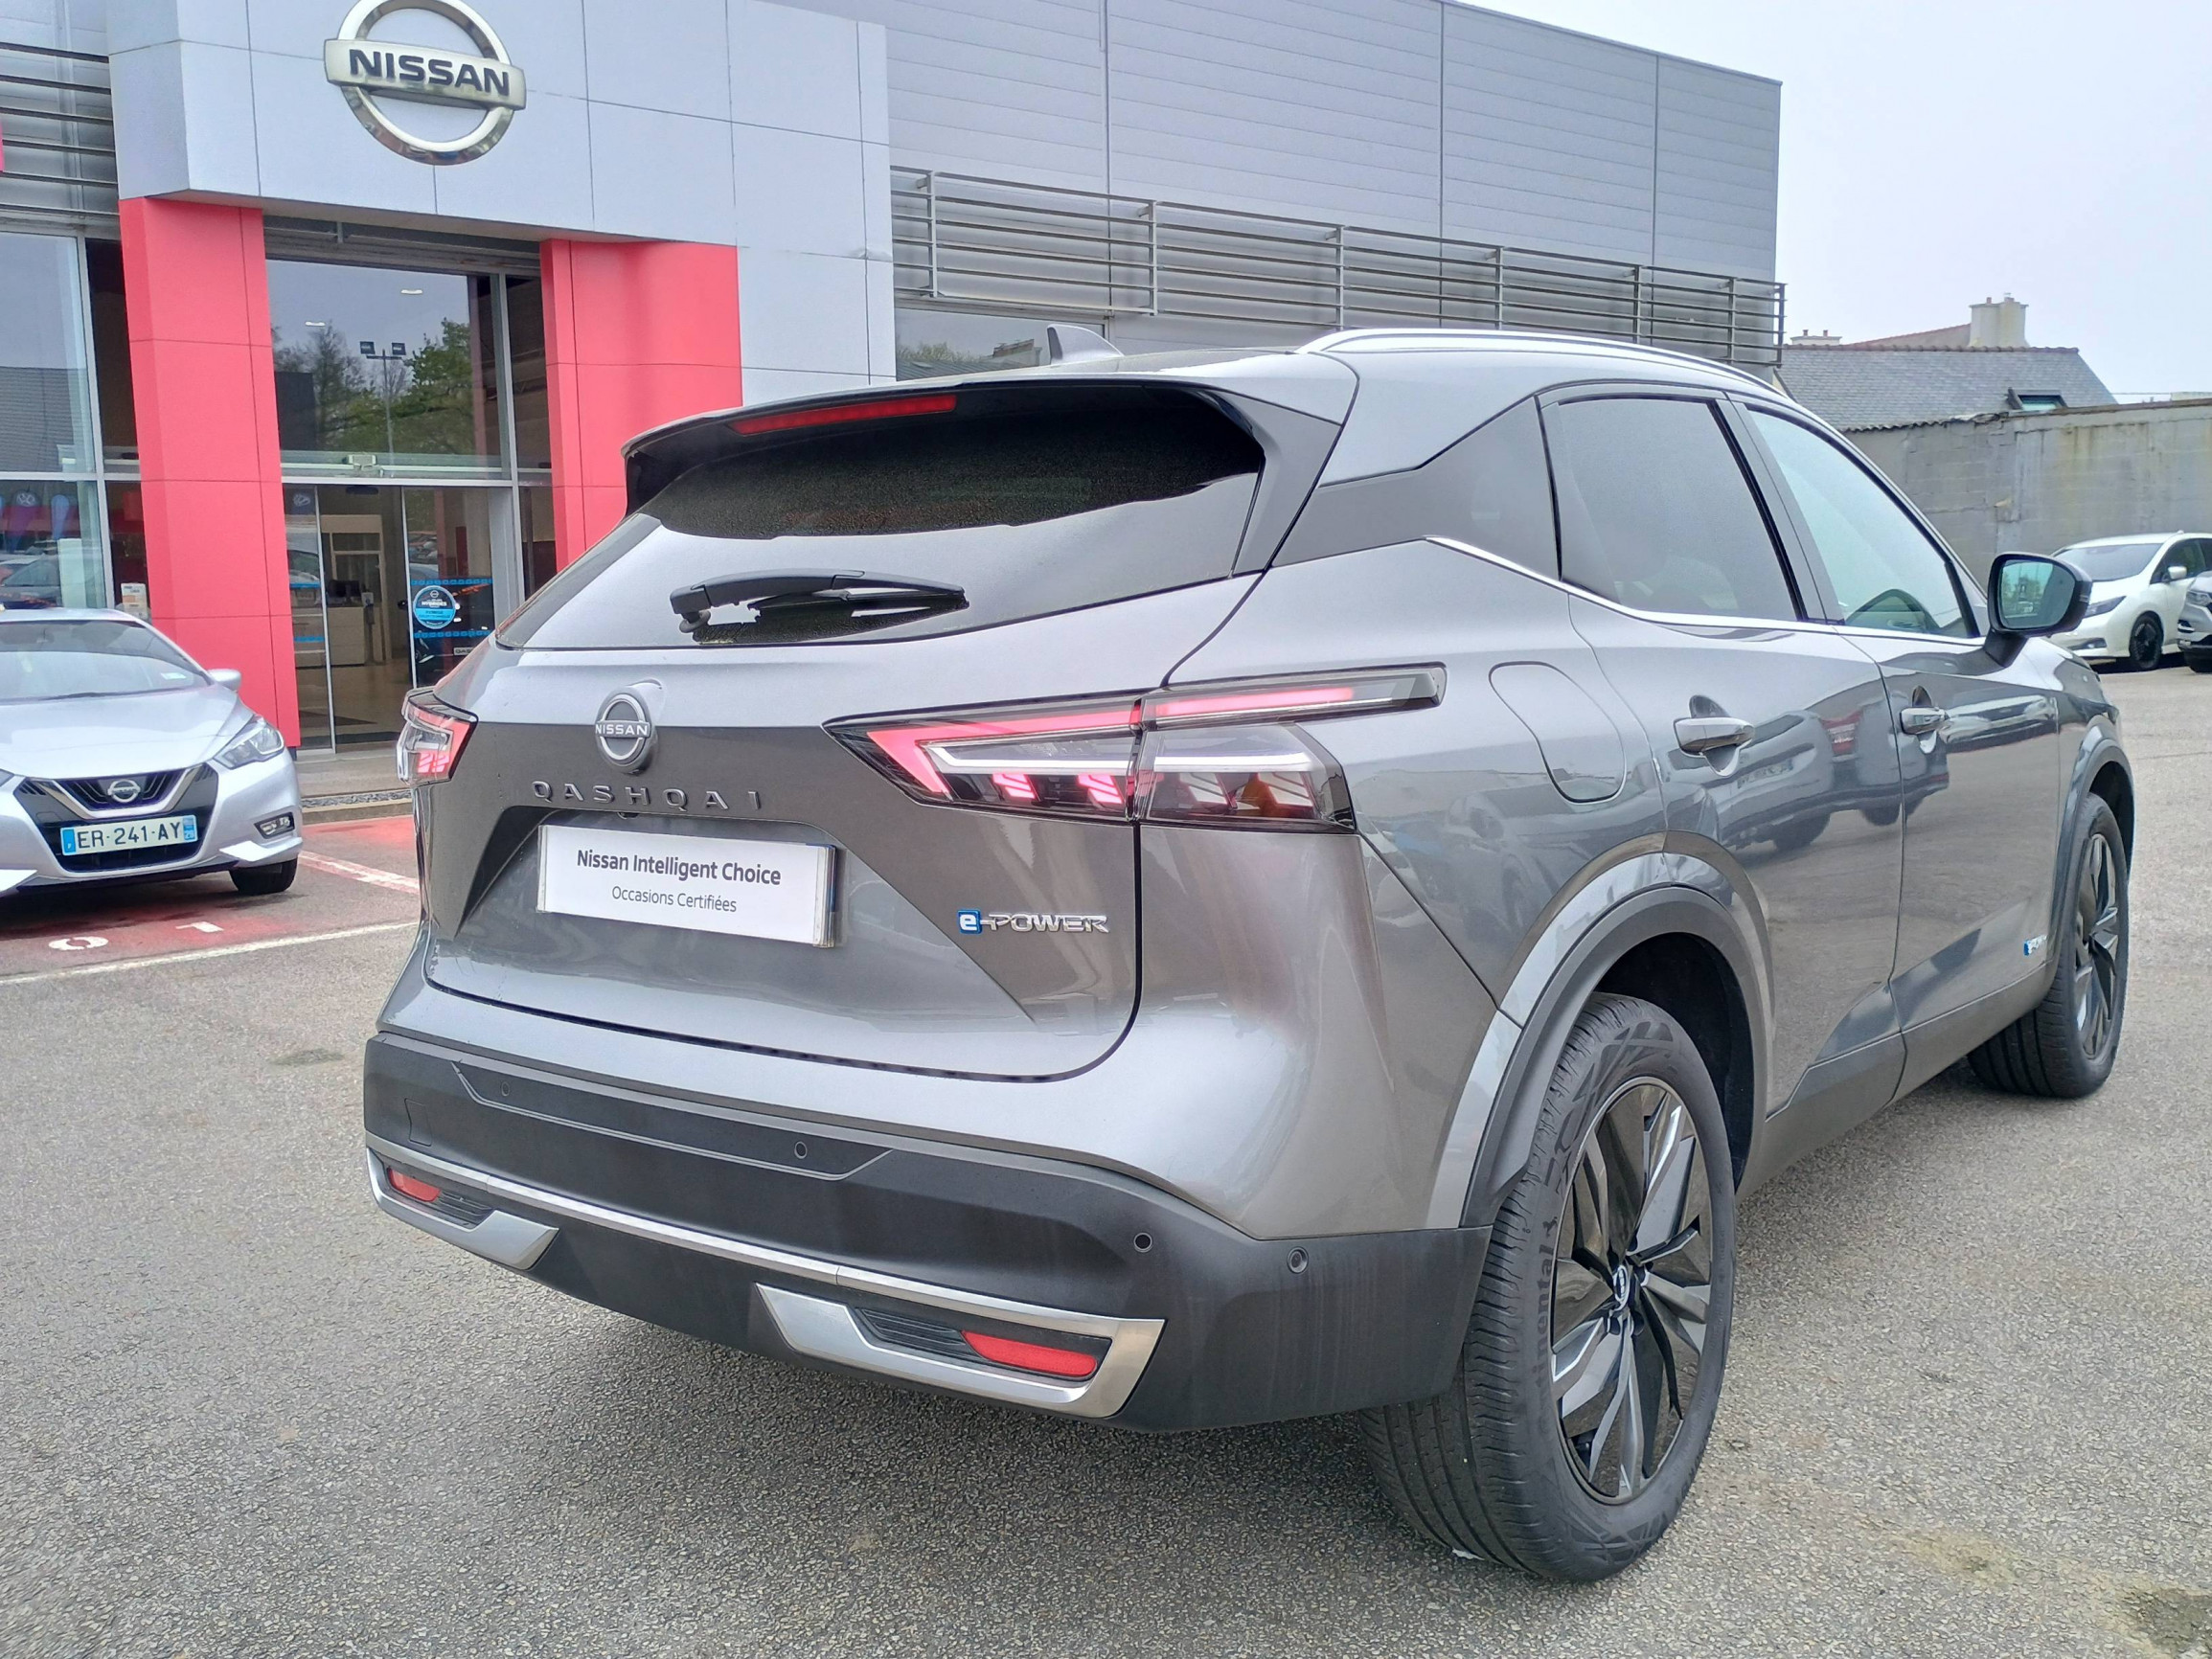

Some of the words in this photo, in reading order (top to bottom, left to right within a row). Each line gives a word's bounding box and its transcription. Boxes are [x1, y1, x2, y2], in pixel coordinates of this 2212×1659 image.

[349, 49, 510, 97] NISSAN
[595, 723, 648, 736] NISSAN
[532, 781, 762, 811] QASHQAI
[77, 822, 181, 849] ER-241-AY
[577, 850, 629, 871] Nissan
[633, 854, 718, 881] Intelligent
[721, 862, 782, 886] Choice
[611, 885, 674, 905] Occasions
[676, 893, 738, 912] Certifiées
[1535, 1244, 1554, 1435] tinental
